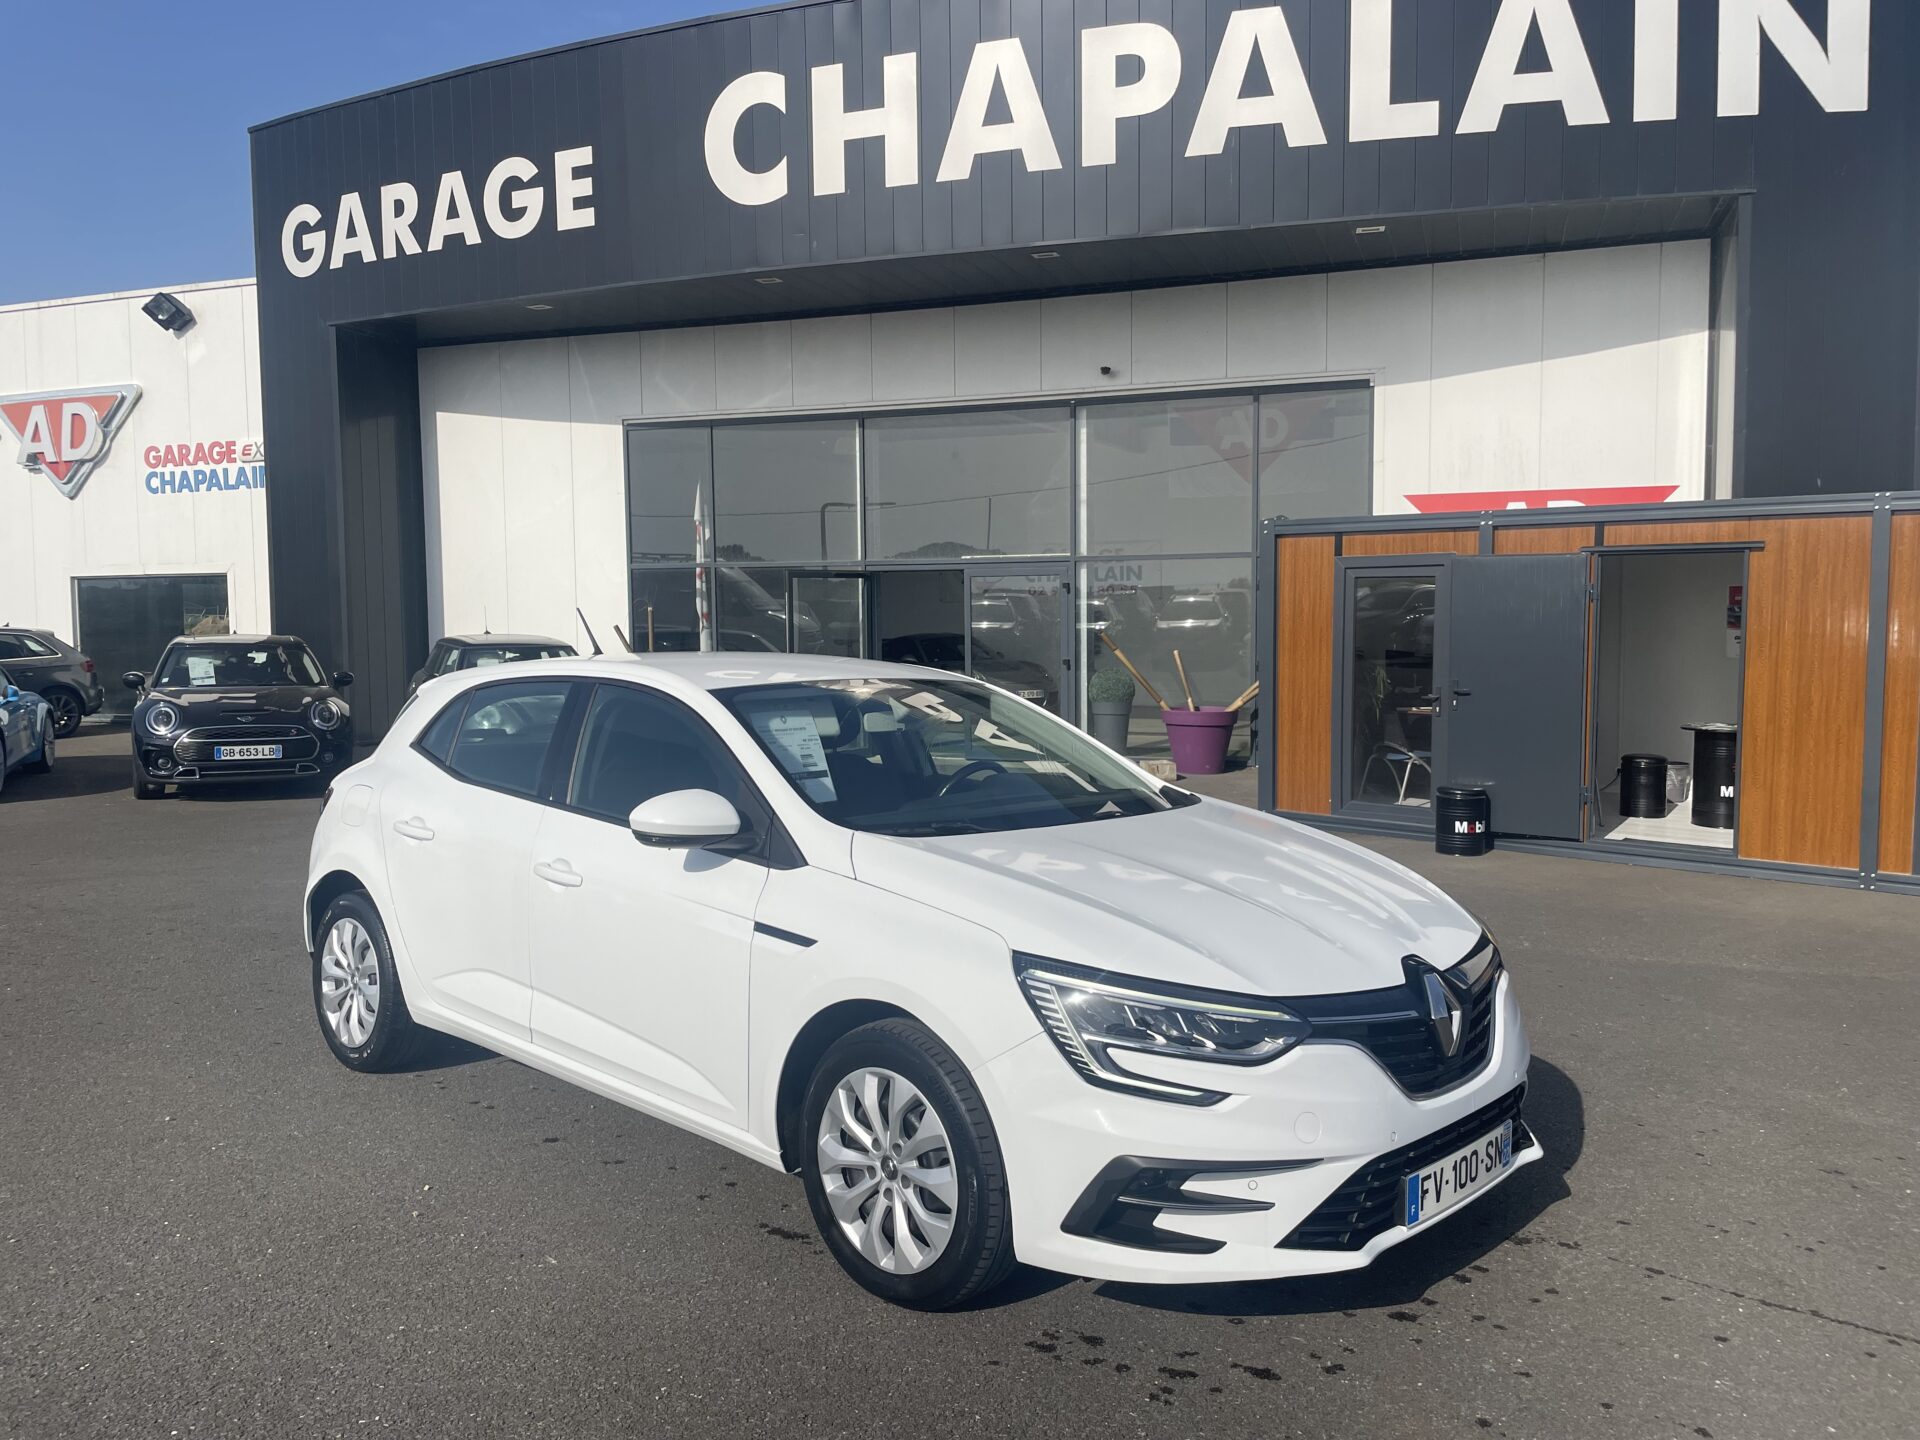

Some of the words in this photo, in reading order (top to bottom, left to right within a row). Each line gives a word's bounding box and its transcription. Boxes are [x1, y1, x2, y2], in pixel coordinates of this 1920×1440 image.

[281, 145, 595, 278] GARAGE
[704, 0, 1870, 206] CHAPALAIN
[17, 401, 100, 464] AD
[144, 441, 237, 469] GARAGE
